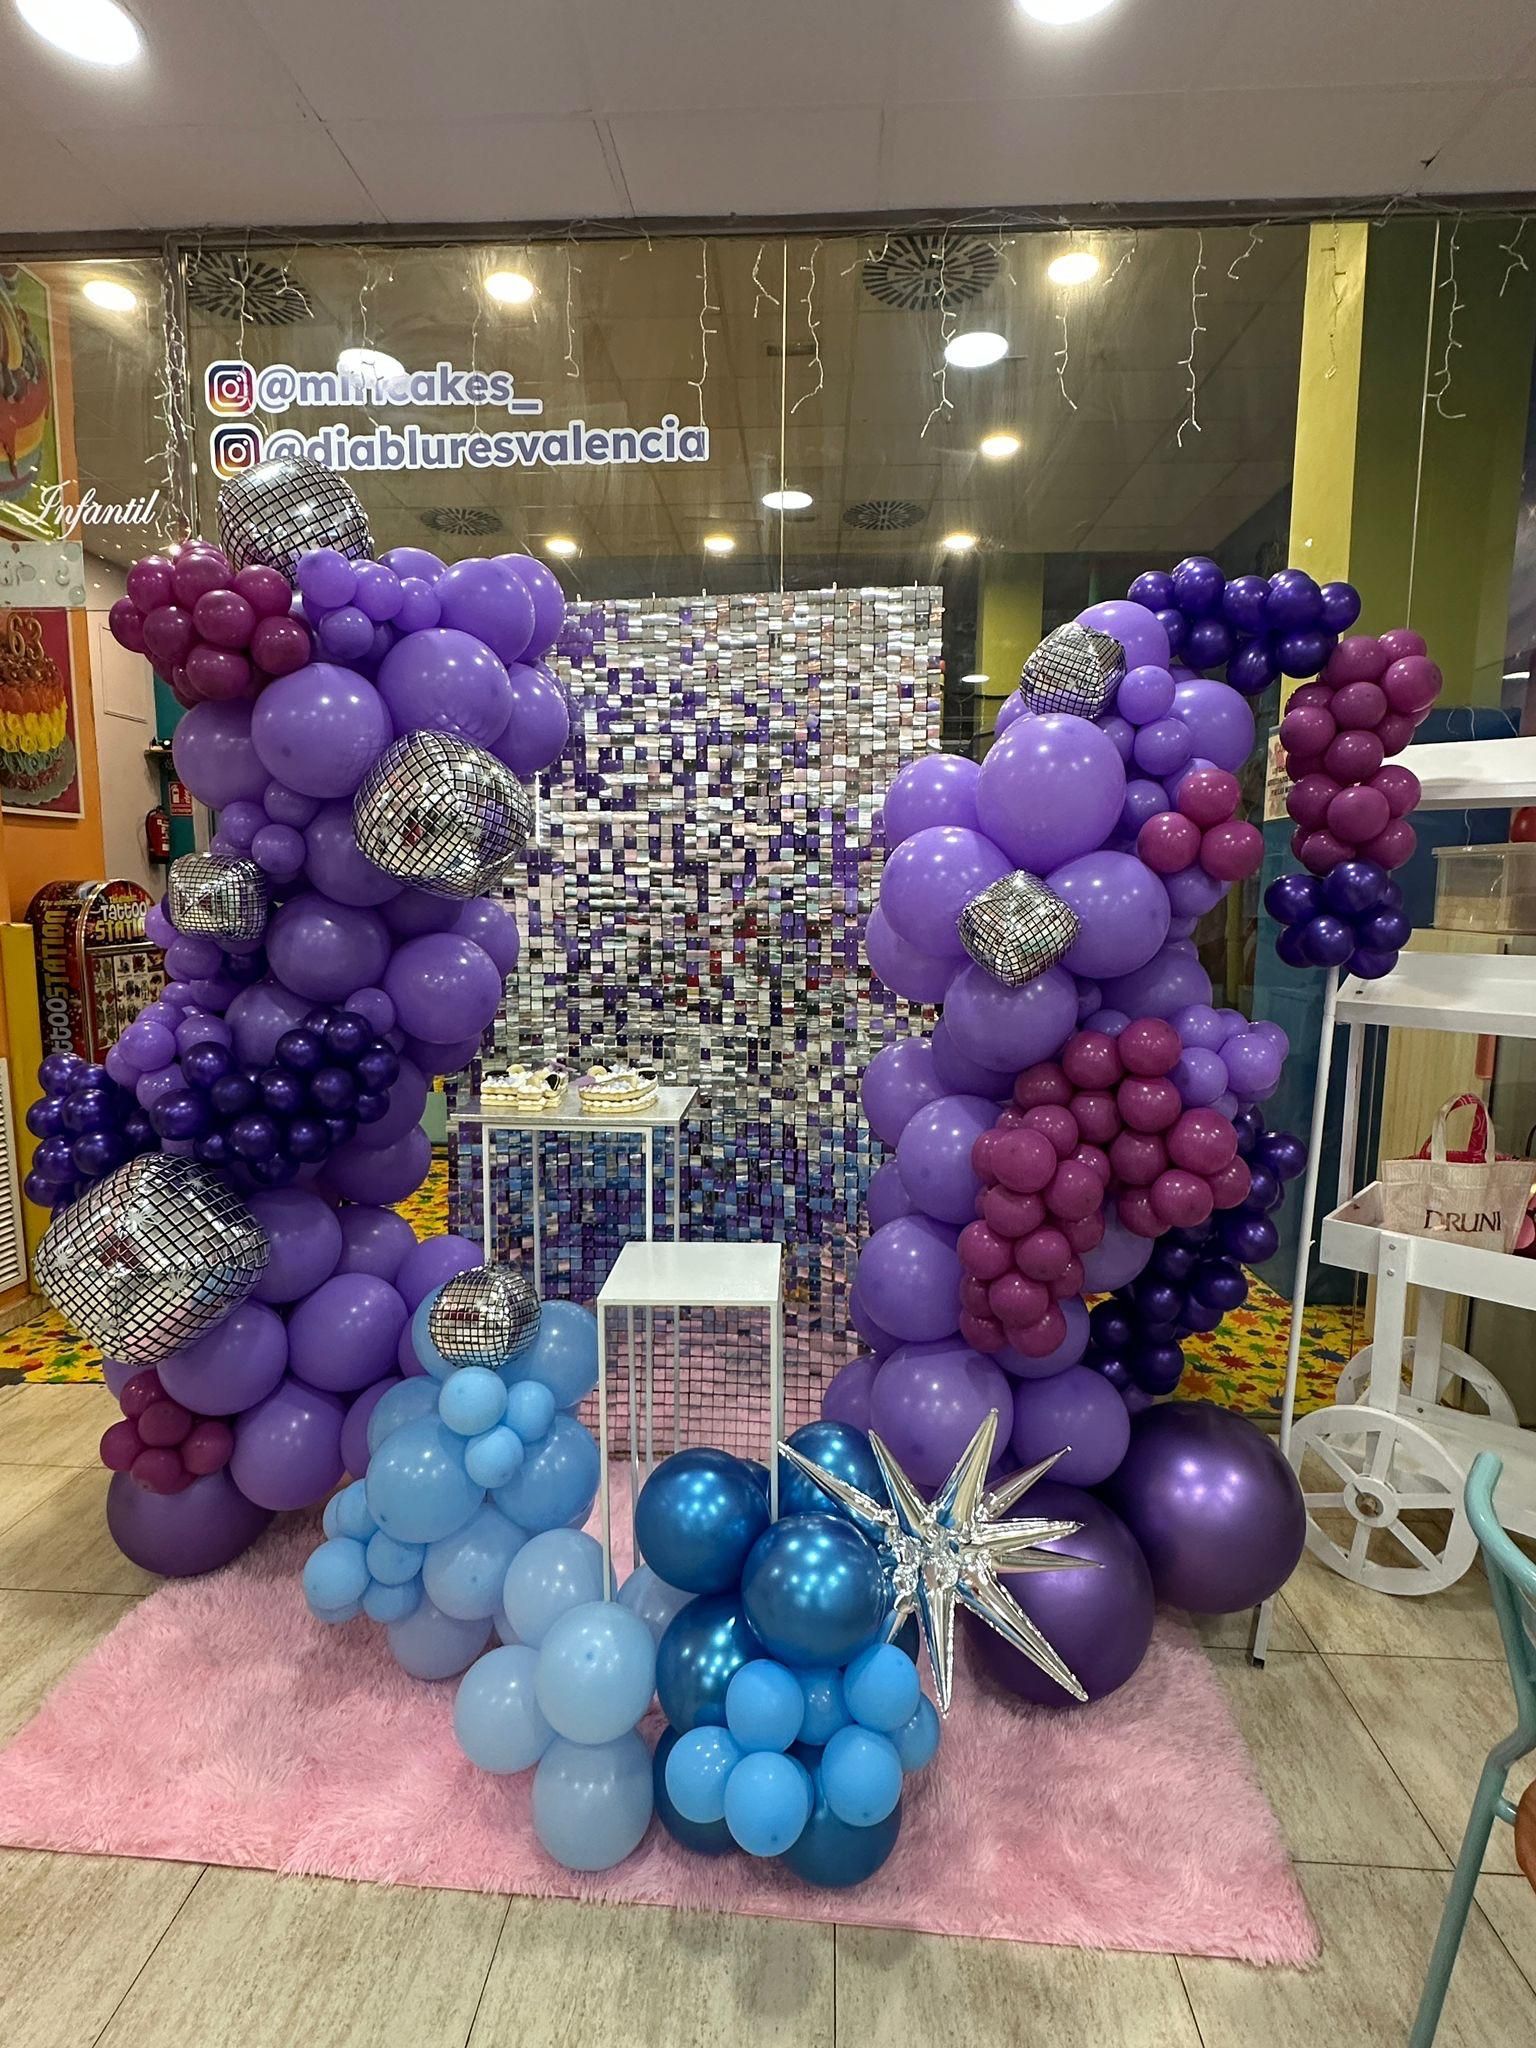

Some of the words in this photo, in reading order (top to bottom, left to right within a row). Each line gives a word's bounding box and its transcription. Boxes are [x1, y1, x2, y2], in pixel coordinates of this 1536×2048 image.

[18, 480, 160, 539] Infantil
[95, 917, 146, 941] STATIO
[1424, 1209, 1501, 1233] DRUNI
